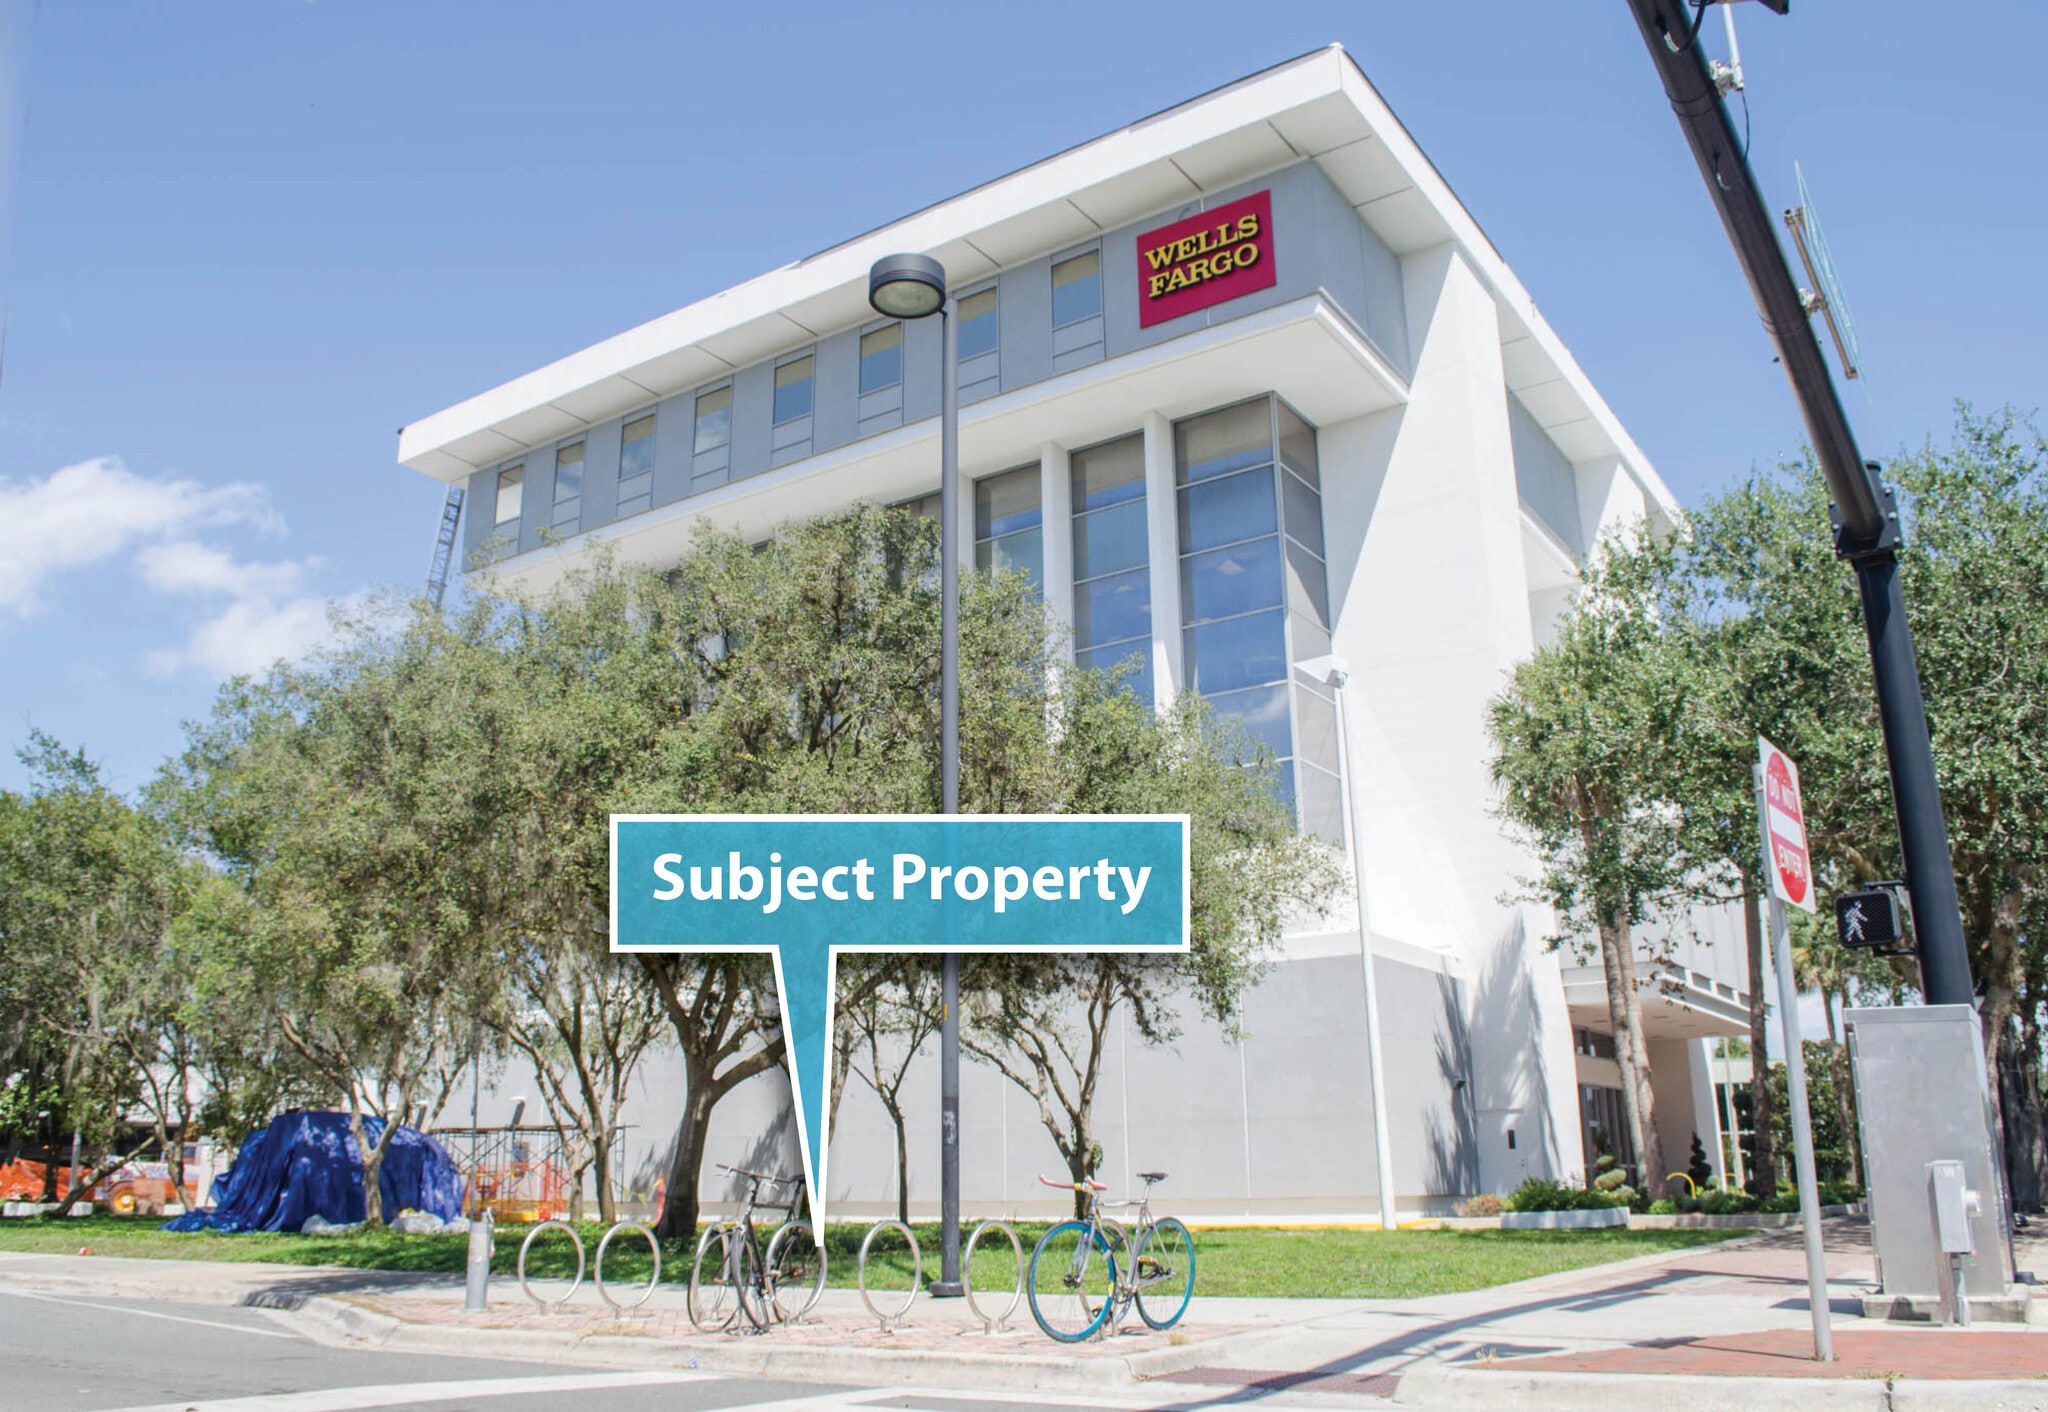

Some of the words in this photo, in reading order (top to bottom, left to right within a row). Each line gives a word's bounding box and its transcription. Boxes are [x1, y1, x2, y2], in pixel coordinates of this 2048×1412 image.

[1145, 213, 1259, 270] WELLS
[1148, 243, 1259, 298] FARGO
[1768, 774, 1780, 801] DO
[1781, 784, 1796, 813] NOT
[1778, 845, 1803, 878] ENTER
